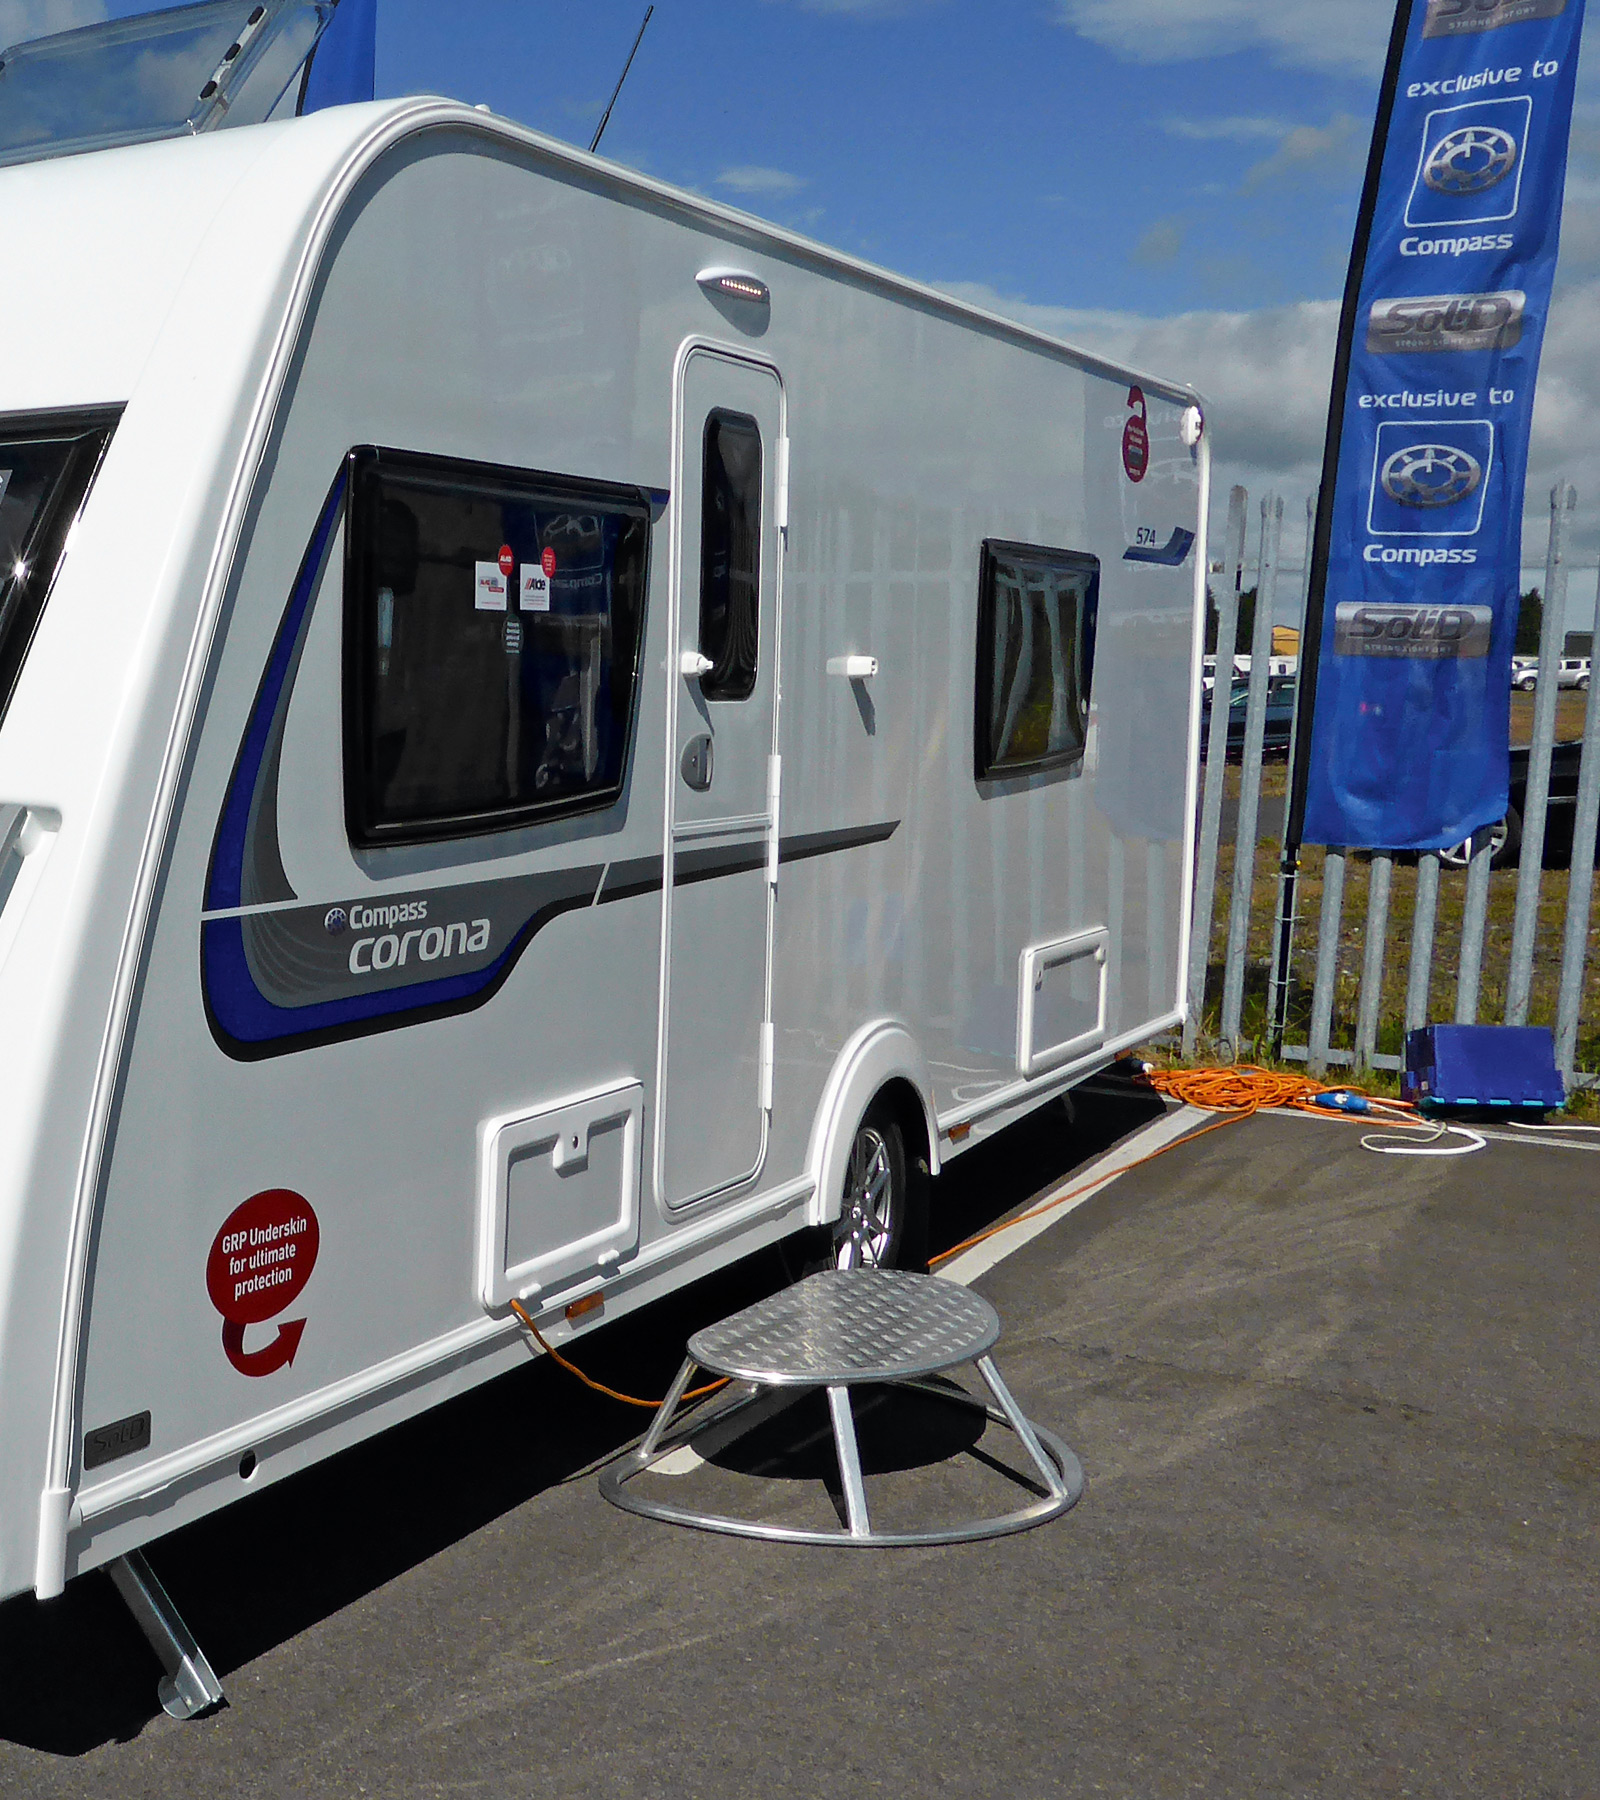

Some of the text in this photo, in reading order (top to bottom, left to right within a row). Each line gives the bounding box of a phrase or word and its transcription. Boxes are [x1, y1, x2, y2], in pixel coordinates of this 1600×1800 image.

[1407, 60, 1559, 98] exclusive to
[1400, 233, 1514, 257] Compass
[1359, 387, 1515, 409] exclusive to
[1136, 526, 1156, 547] 574
[1362, 543, 1478, 567] Compass
[349, 900, 428, 929] Compass
[348, 918, 491, 975] corona
[222, 1215, 307, 1255] GRP Underskin
[229, 1242, 296, 1276] for ultimate
[234, 1266, 293, 1302] protection
